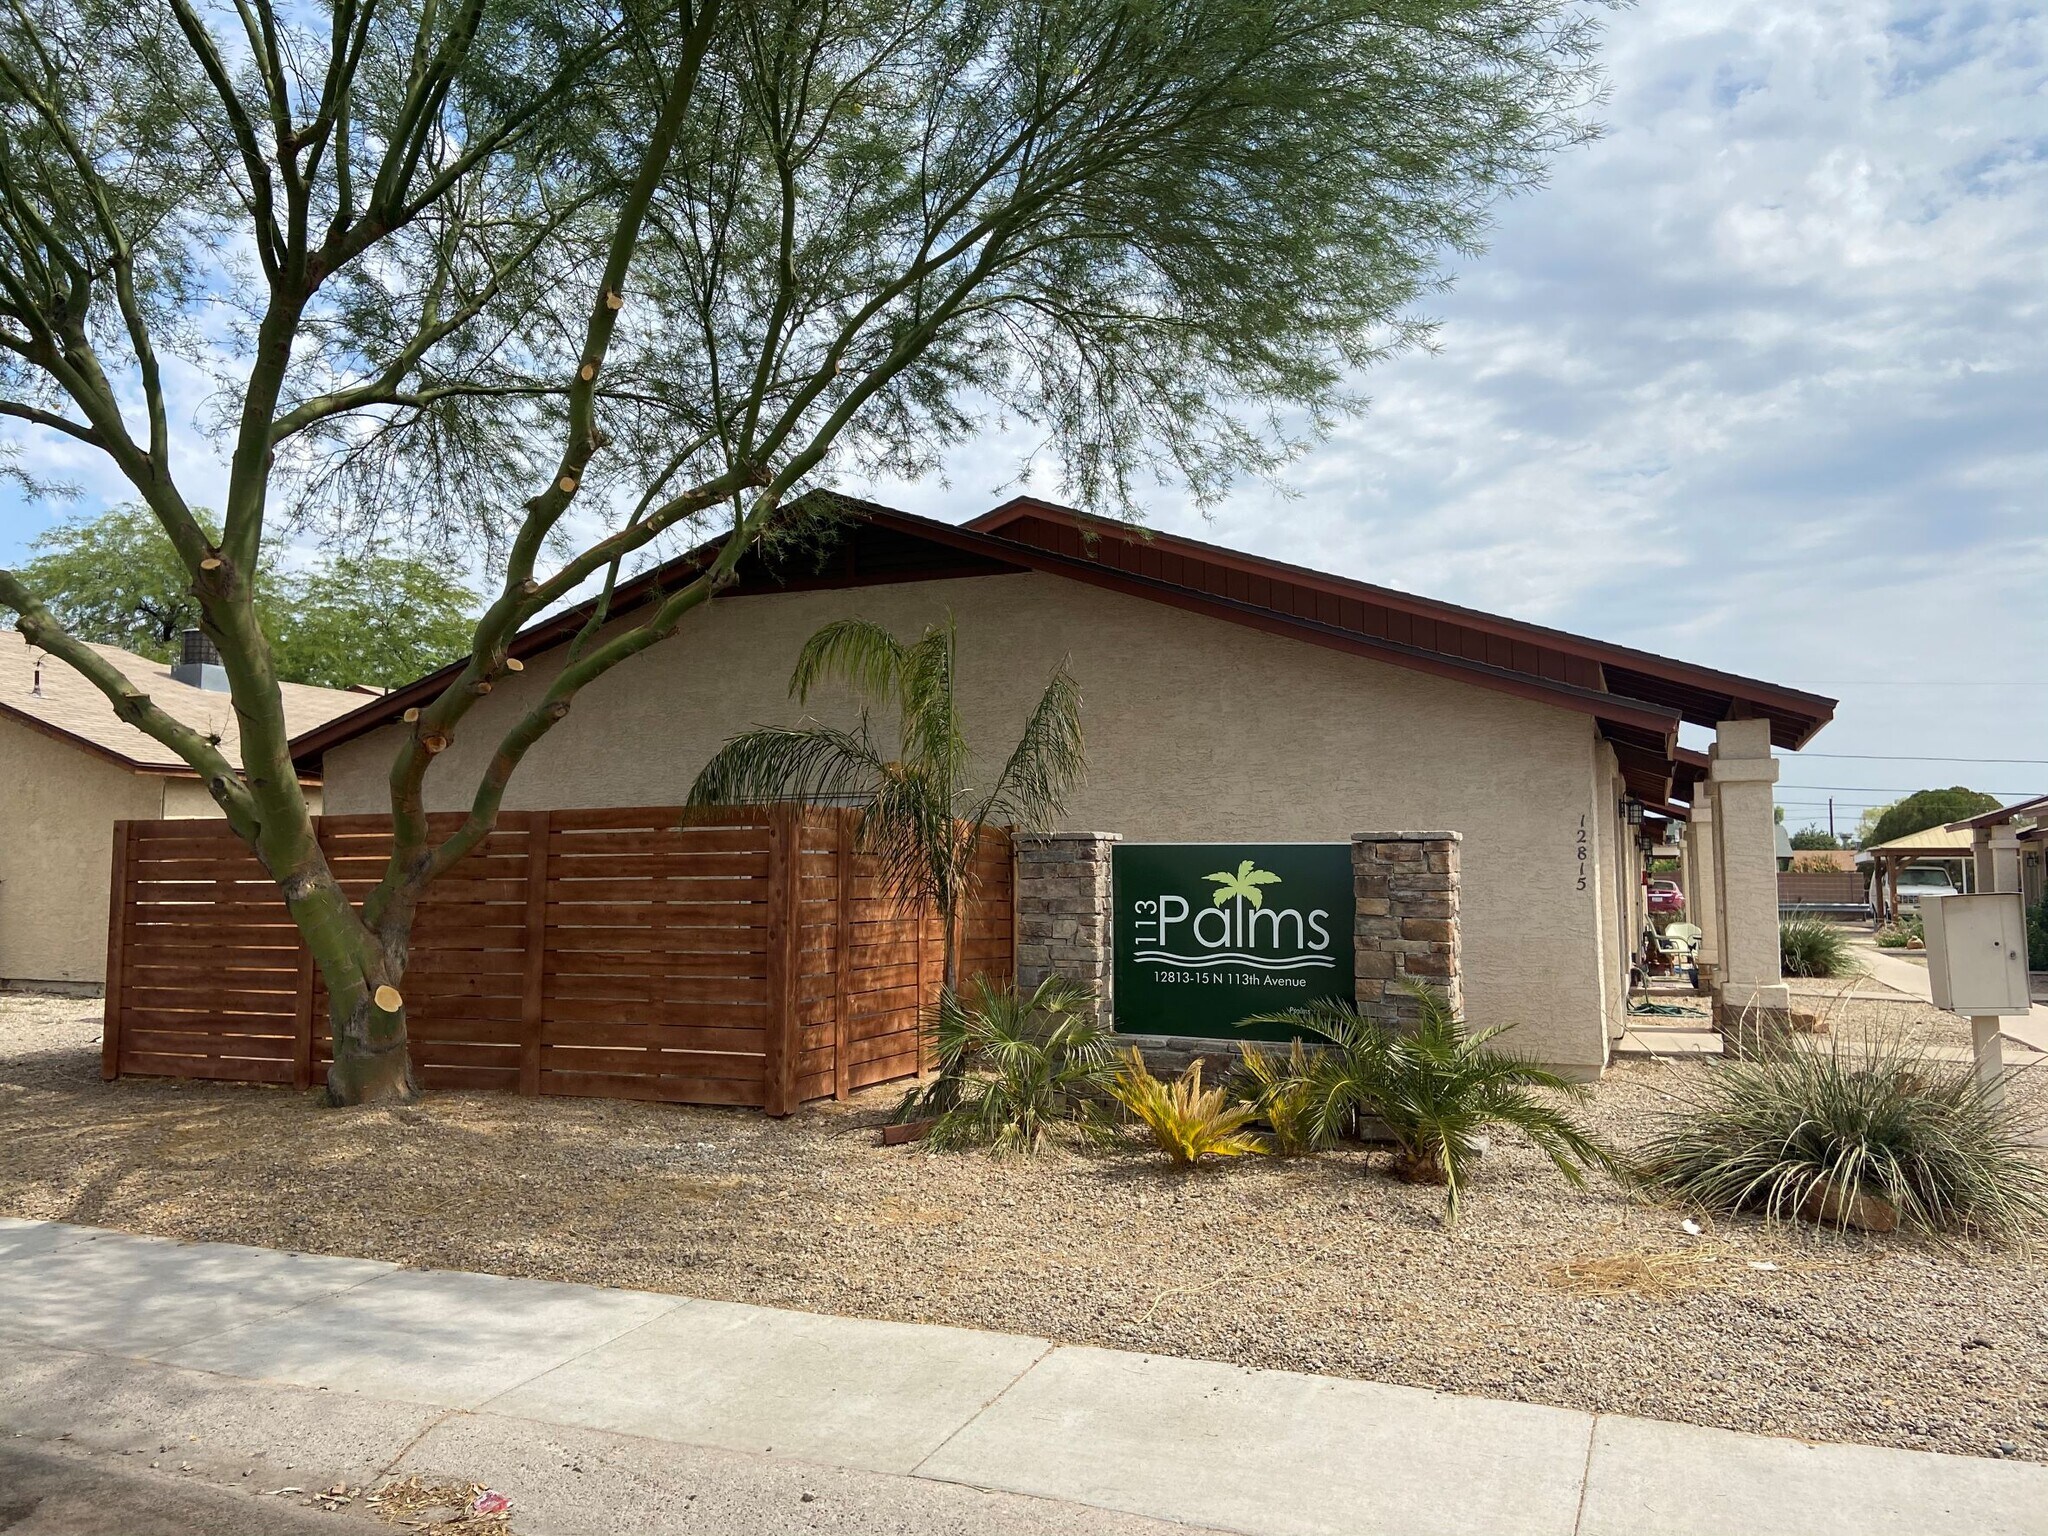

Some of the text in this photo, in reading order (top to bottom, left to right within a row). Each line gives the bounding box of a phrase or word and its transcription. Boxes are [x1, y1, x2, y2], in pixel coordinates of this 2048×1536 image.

[1576, 814, 1587, 891] 12815
[1135, 900, 1157, 945] 113
[1159, 895, 1330, 951] Palms
[1154, 971, 1307, 987] 12813-15 N 113th Avenue
